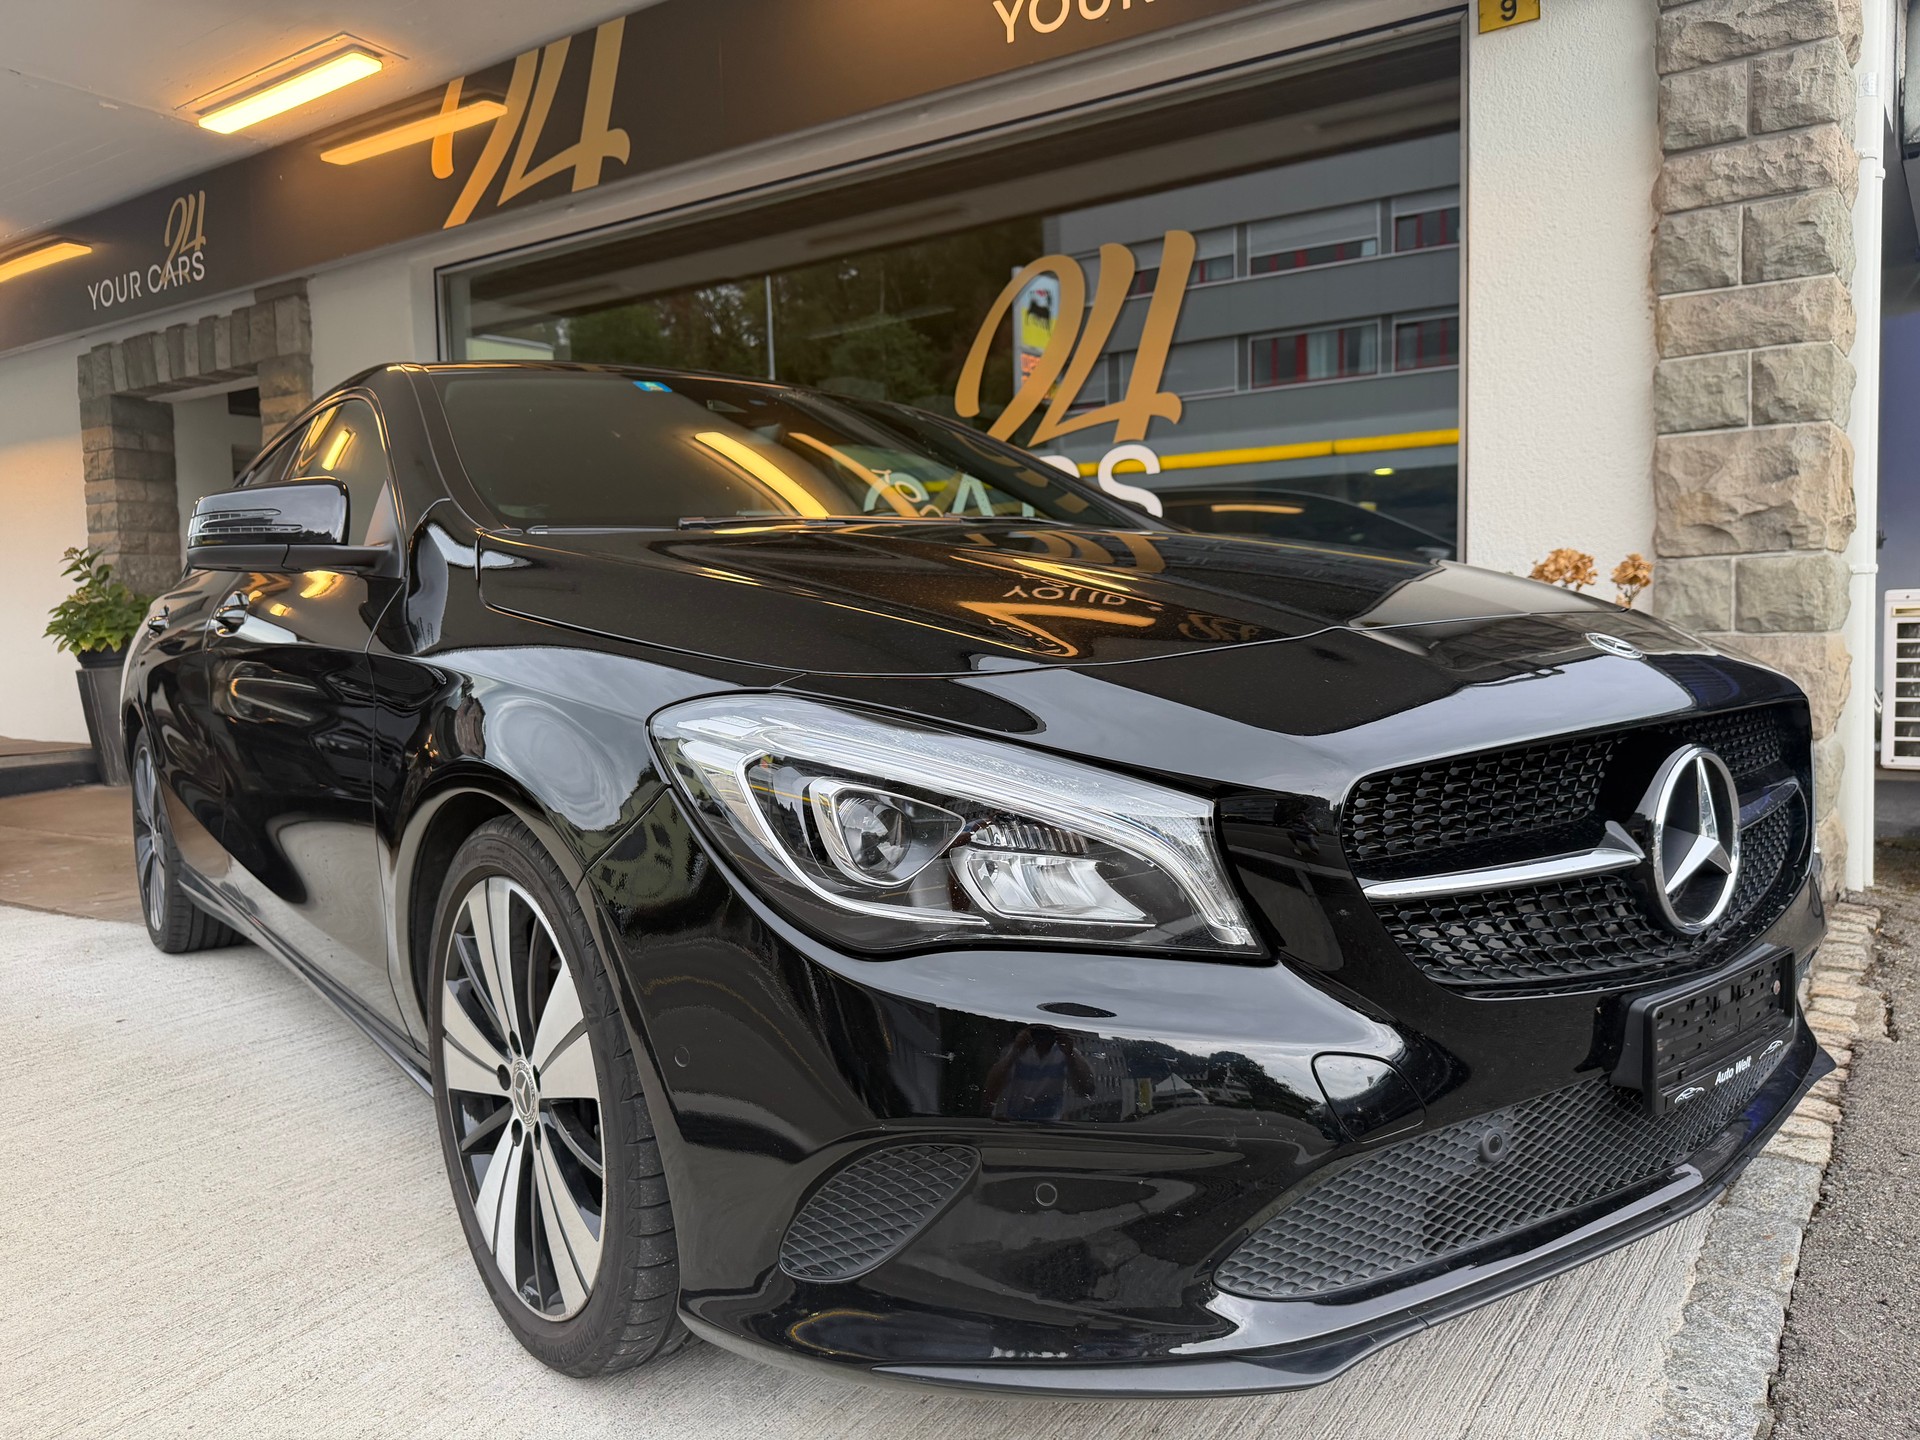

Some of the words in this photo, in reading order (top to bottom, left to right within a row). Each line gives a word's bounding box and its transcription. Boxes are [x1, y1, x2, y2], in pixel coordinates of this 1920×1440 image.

[1501, 0, 1517, 21] 9
[161, 190, 206, 284] 24
[88, 271, 142, 310] YOUR
[147, 251, 205, 293] CARS
[1714, 1068, 1735, 1086] Auto
[1735, 1055, 1752, 1075] Welt
